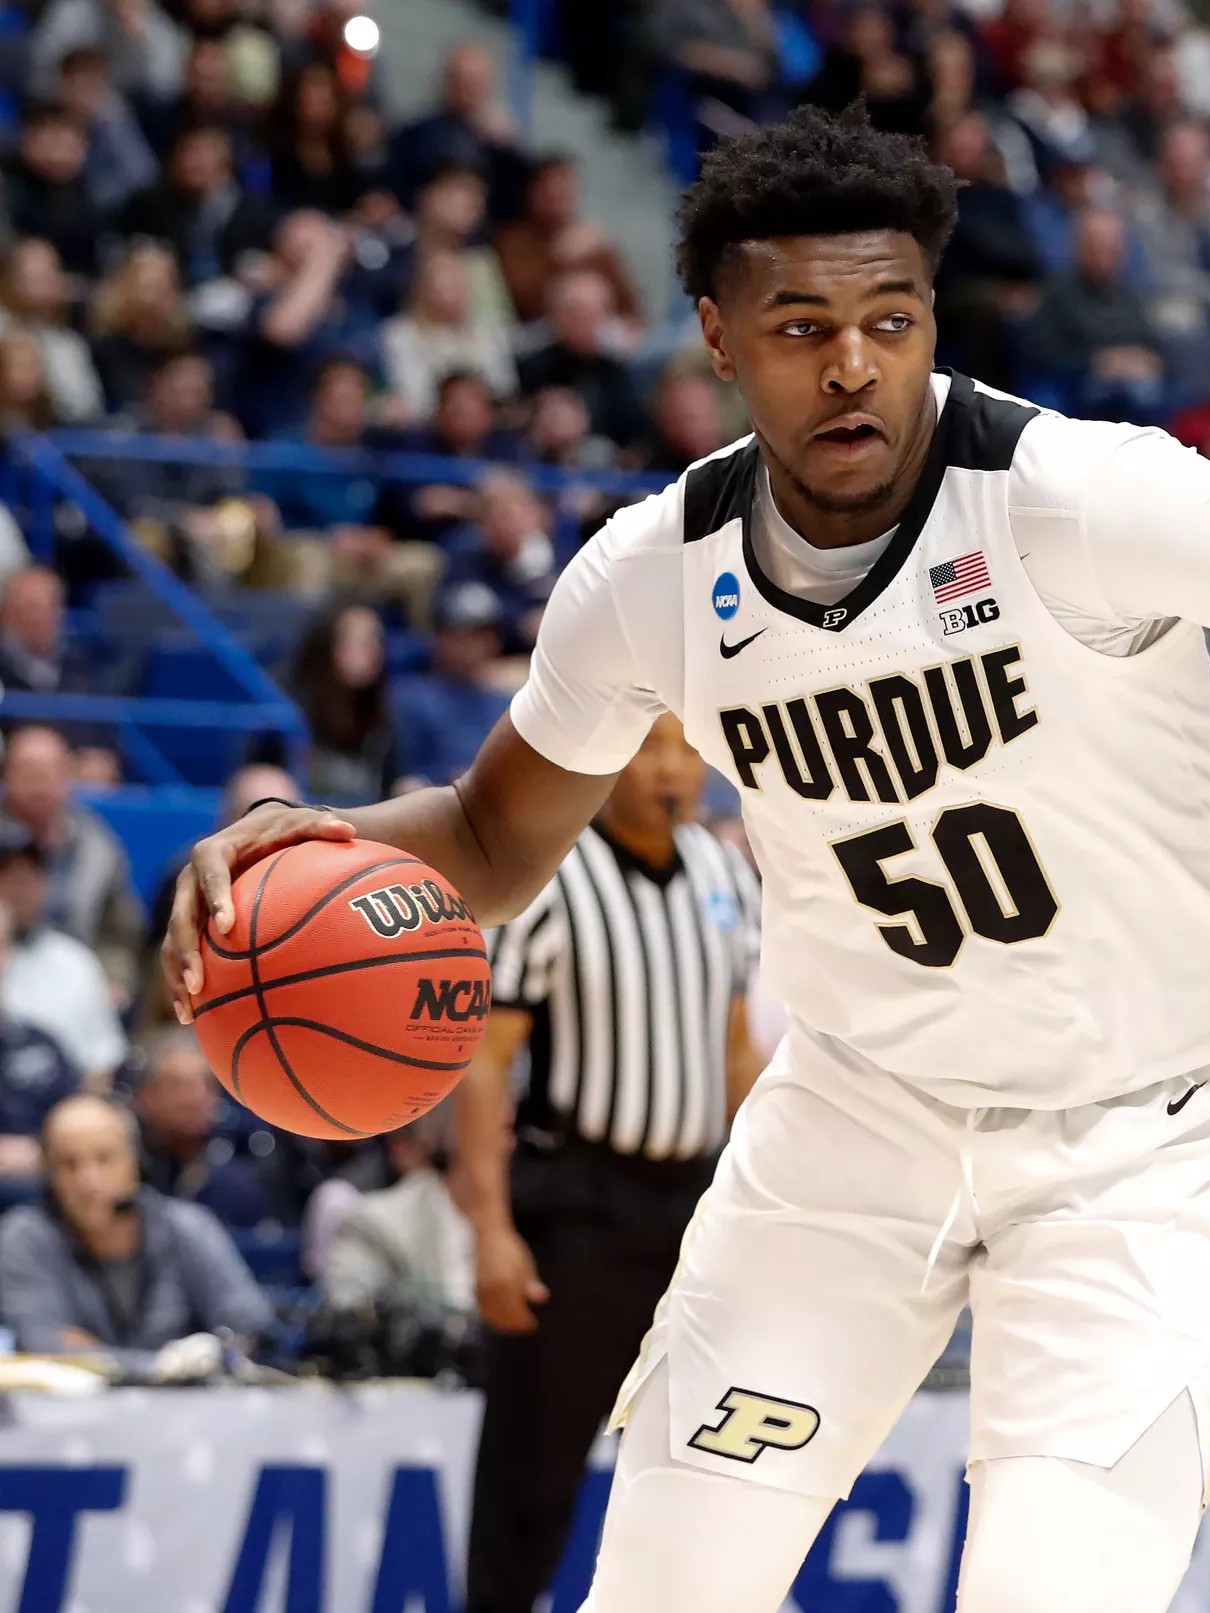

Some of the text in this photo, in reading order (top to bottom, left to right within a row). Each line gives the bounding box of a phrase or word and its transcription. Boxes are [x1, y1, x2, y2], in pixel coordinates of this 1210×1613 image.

[715, 594, 738, 609] NCAA
[822, 608, 848, 628] P
[718, 642, 1041, 806] PURDUE
[348, 879, 477, 939] Wilso
[826, 799, 1062, 968] 50
[686, 1386, 821, 1464] P
